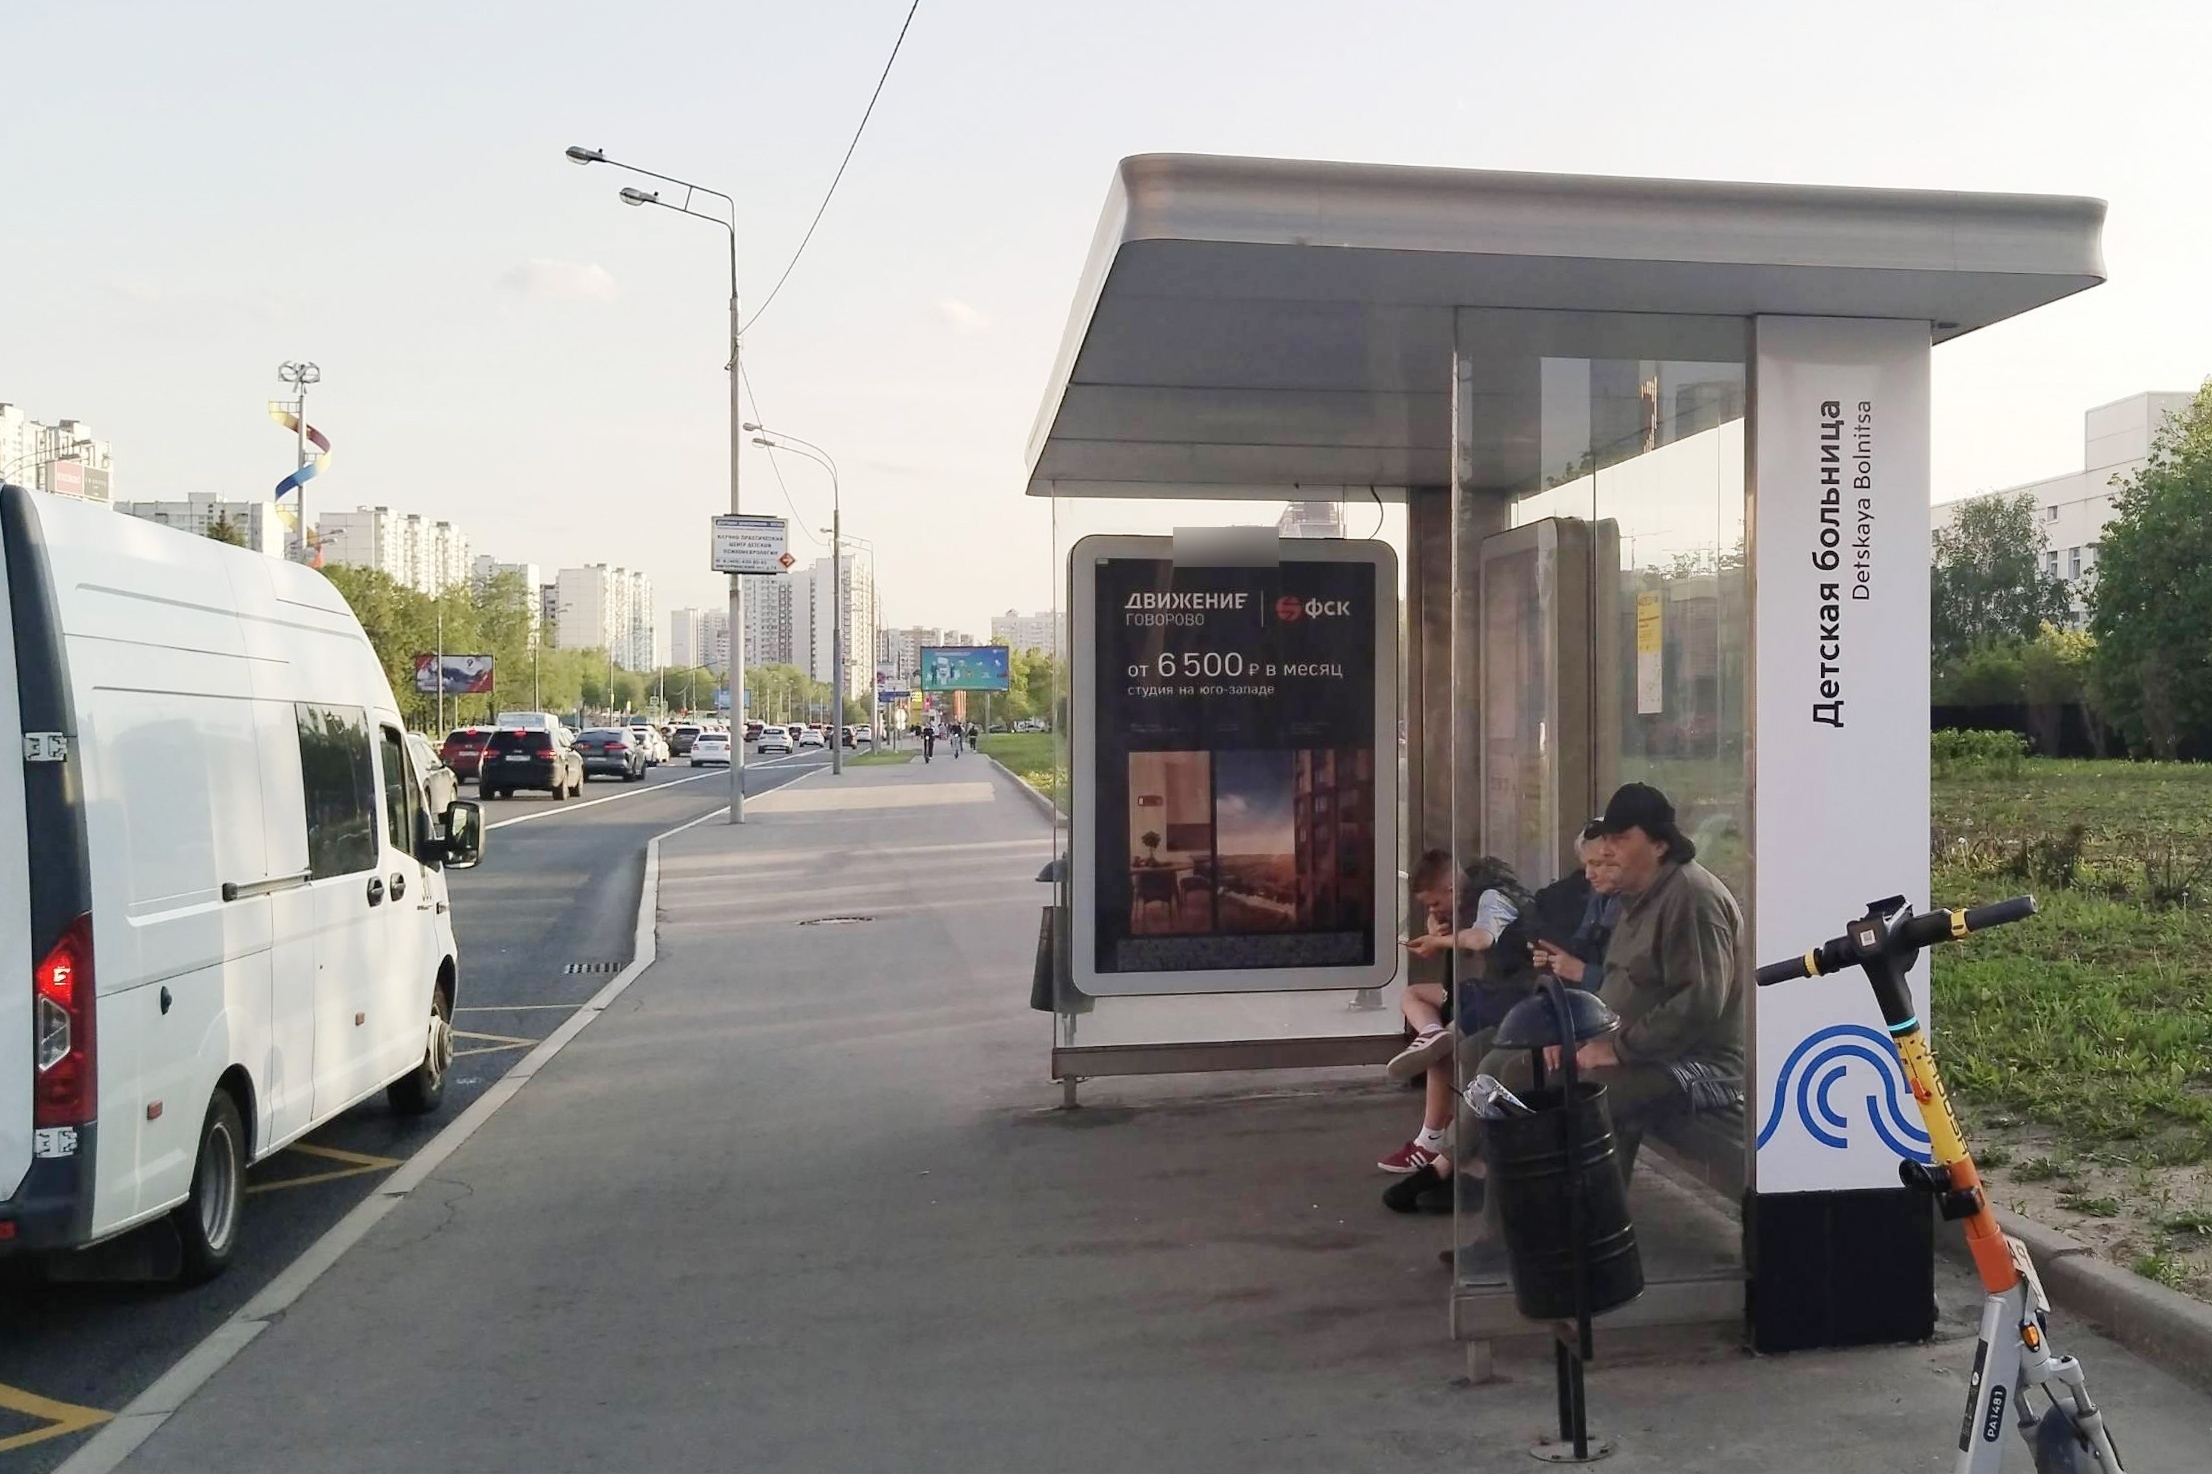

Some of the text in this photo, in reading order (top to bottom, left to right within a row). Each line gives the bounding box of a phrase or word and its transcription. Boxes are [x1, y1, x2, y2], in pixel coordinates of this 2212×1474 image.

[1852, 400, 1875, 601] Detskaya Bolnitsa
[1812, 400, 1844, 728] Детская больница
[1124, 592, 1249, 611] ДВИЖЕНИЕ
[1304, 597, 1351, 619] ФСК
[1125, 612, 1205, 627] ГОВОРОВО
[1127, 664, 1150, 678] от
[1265, 664, 1277, 677] в
[1283, 663, 1344, 679] месяц
[1127, 684, 1275, 698] студия на юго-западе
[1987, 1390, 2004, 1438] PA1481
